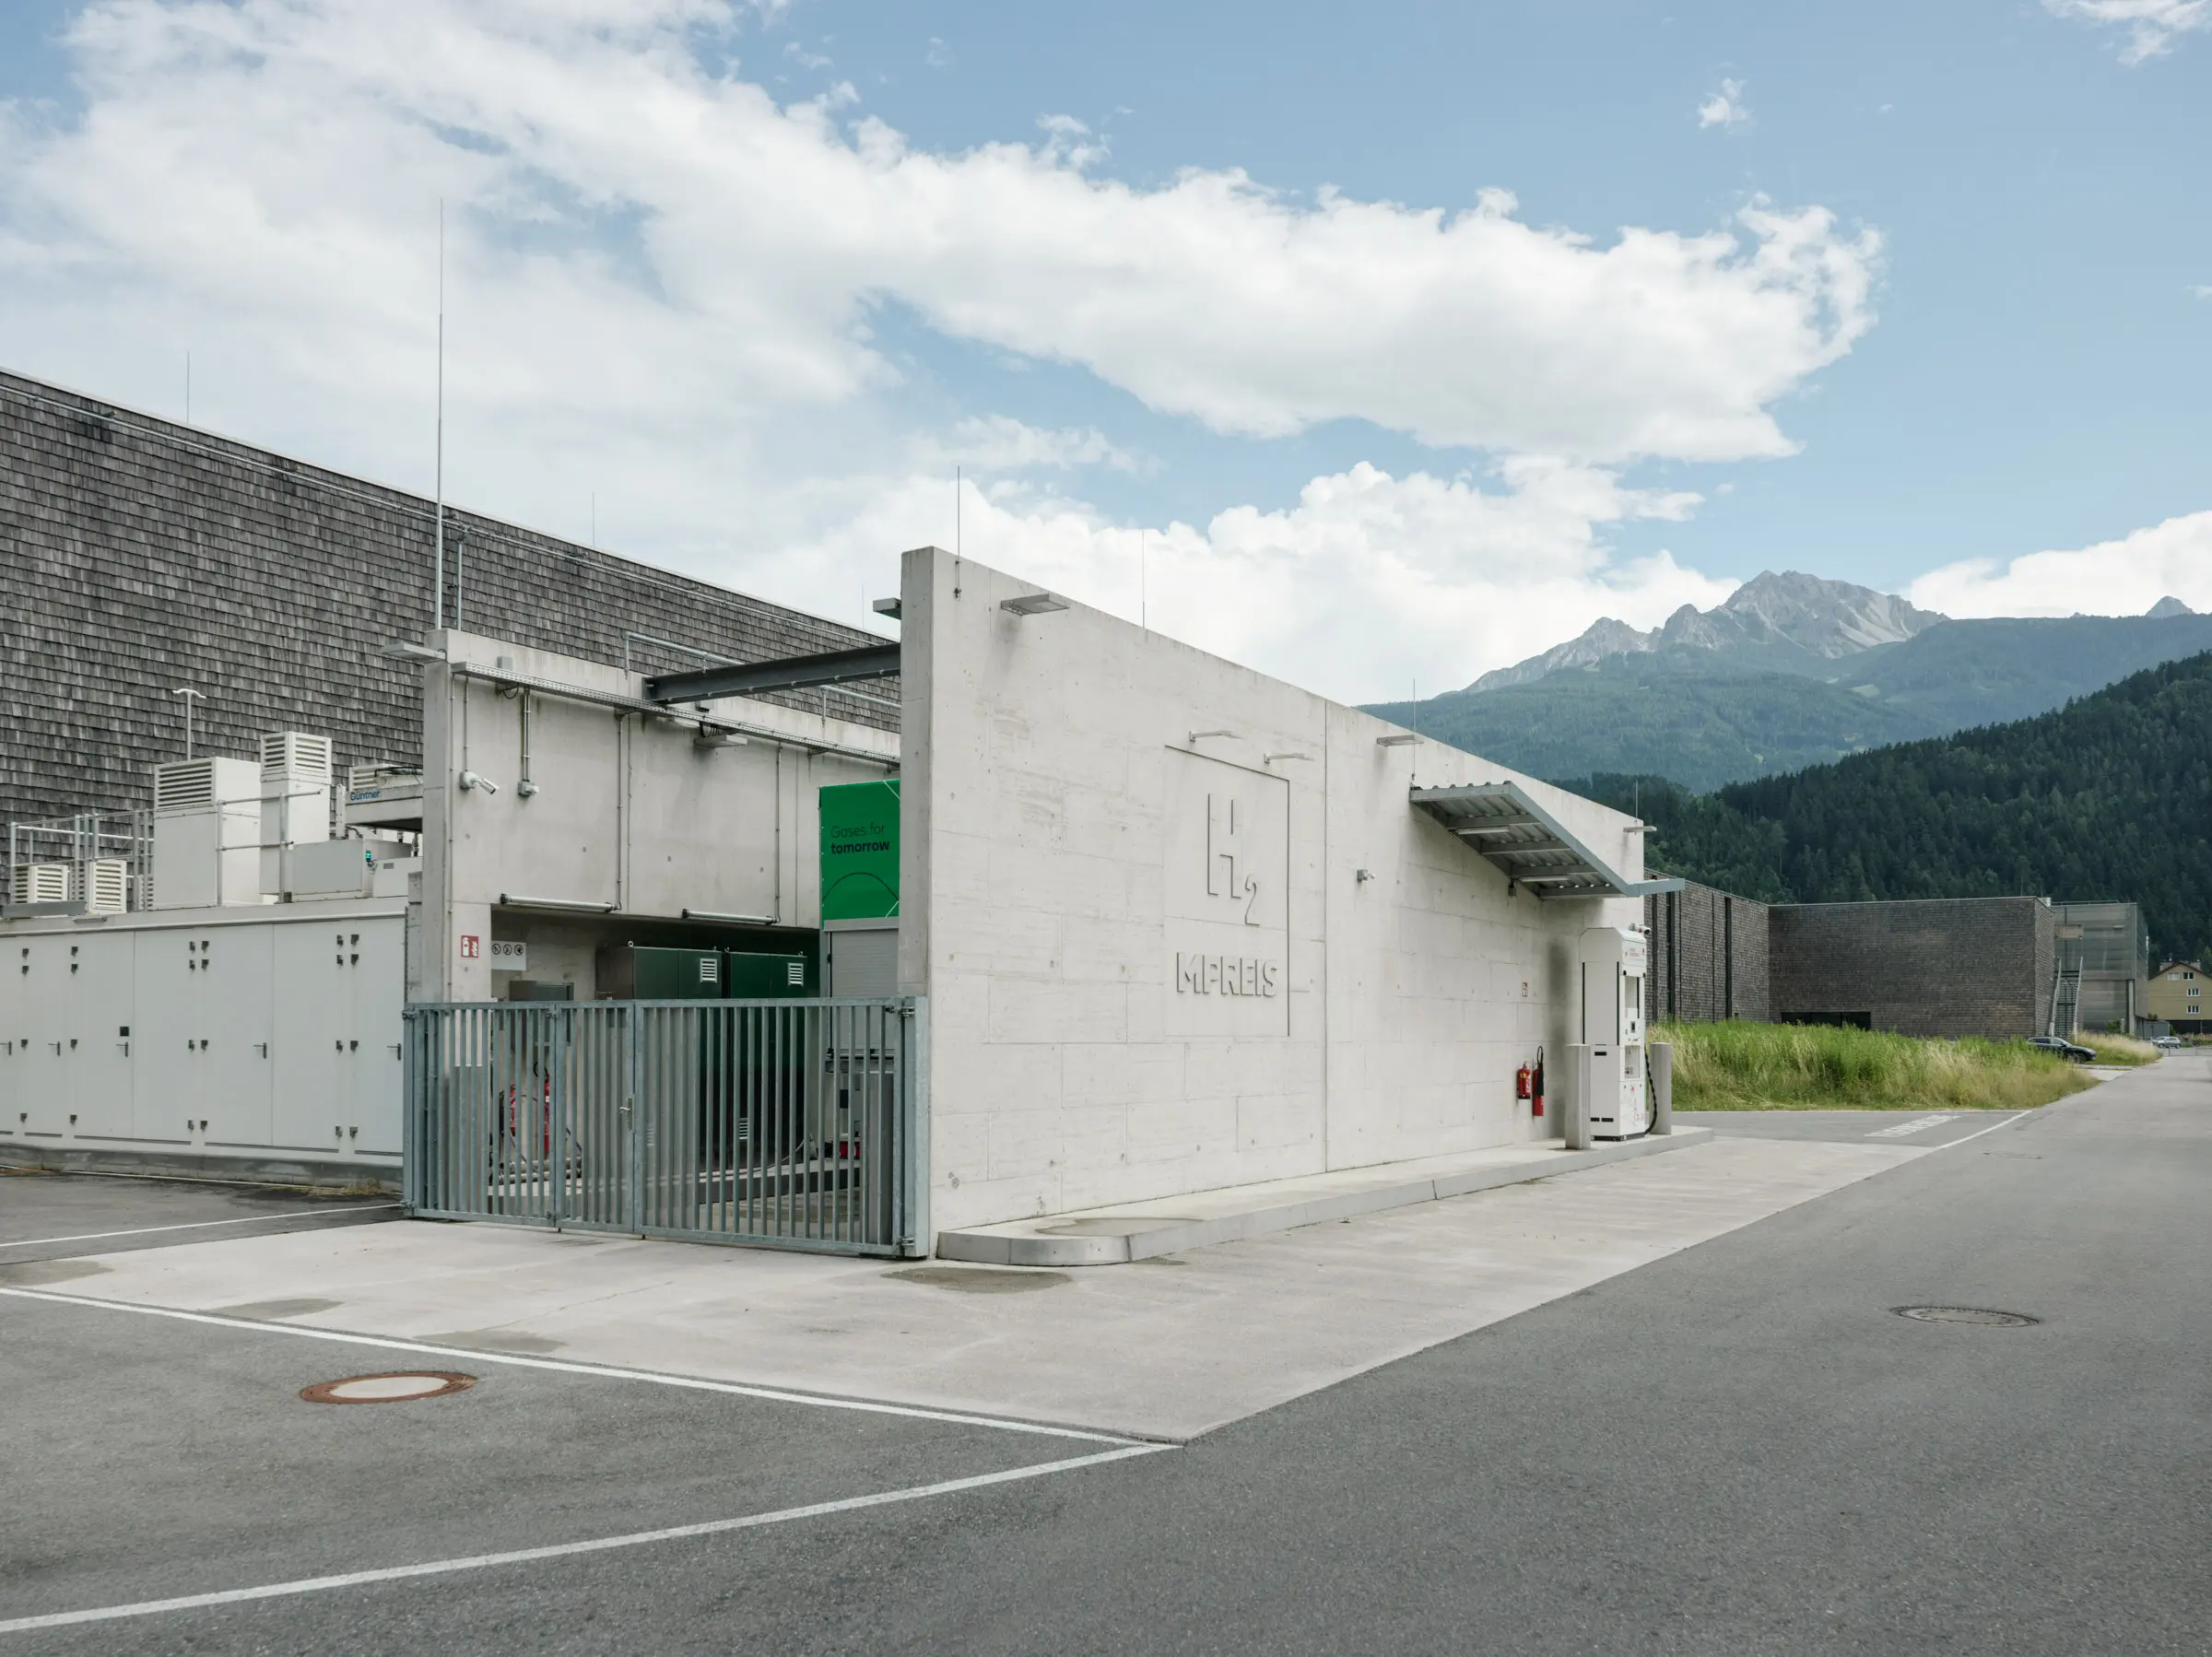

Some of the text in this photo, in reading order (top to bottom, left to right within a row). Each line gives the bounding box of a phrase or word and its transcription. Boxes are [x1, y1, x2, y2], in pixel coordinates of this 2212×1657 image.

[830, 822, 885, 838] Gases for
[830, 840, 889, 854] tomorrow
[1176, 952, 1277, 997] MPREIS
